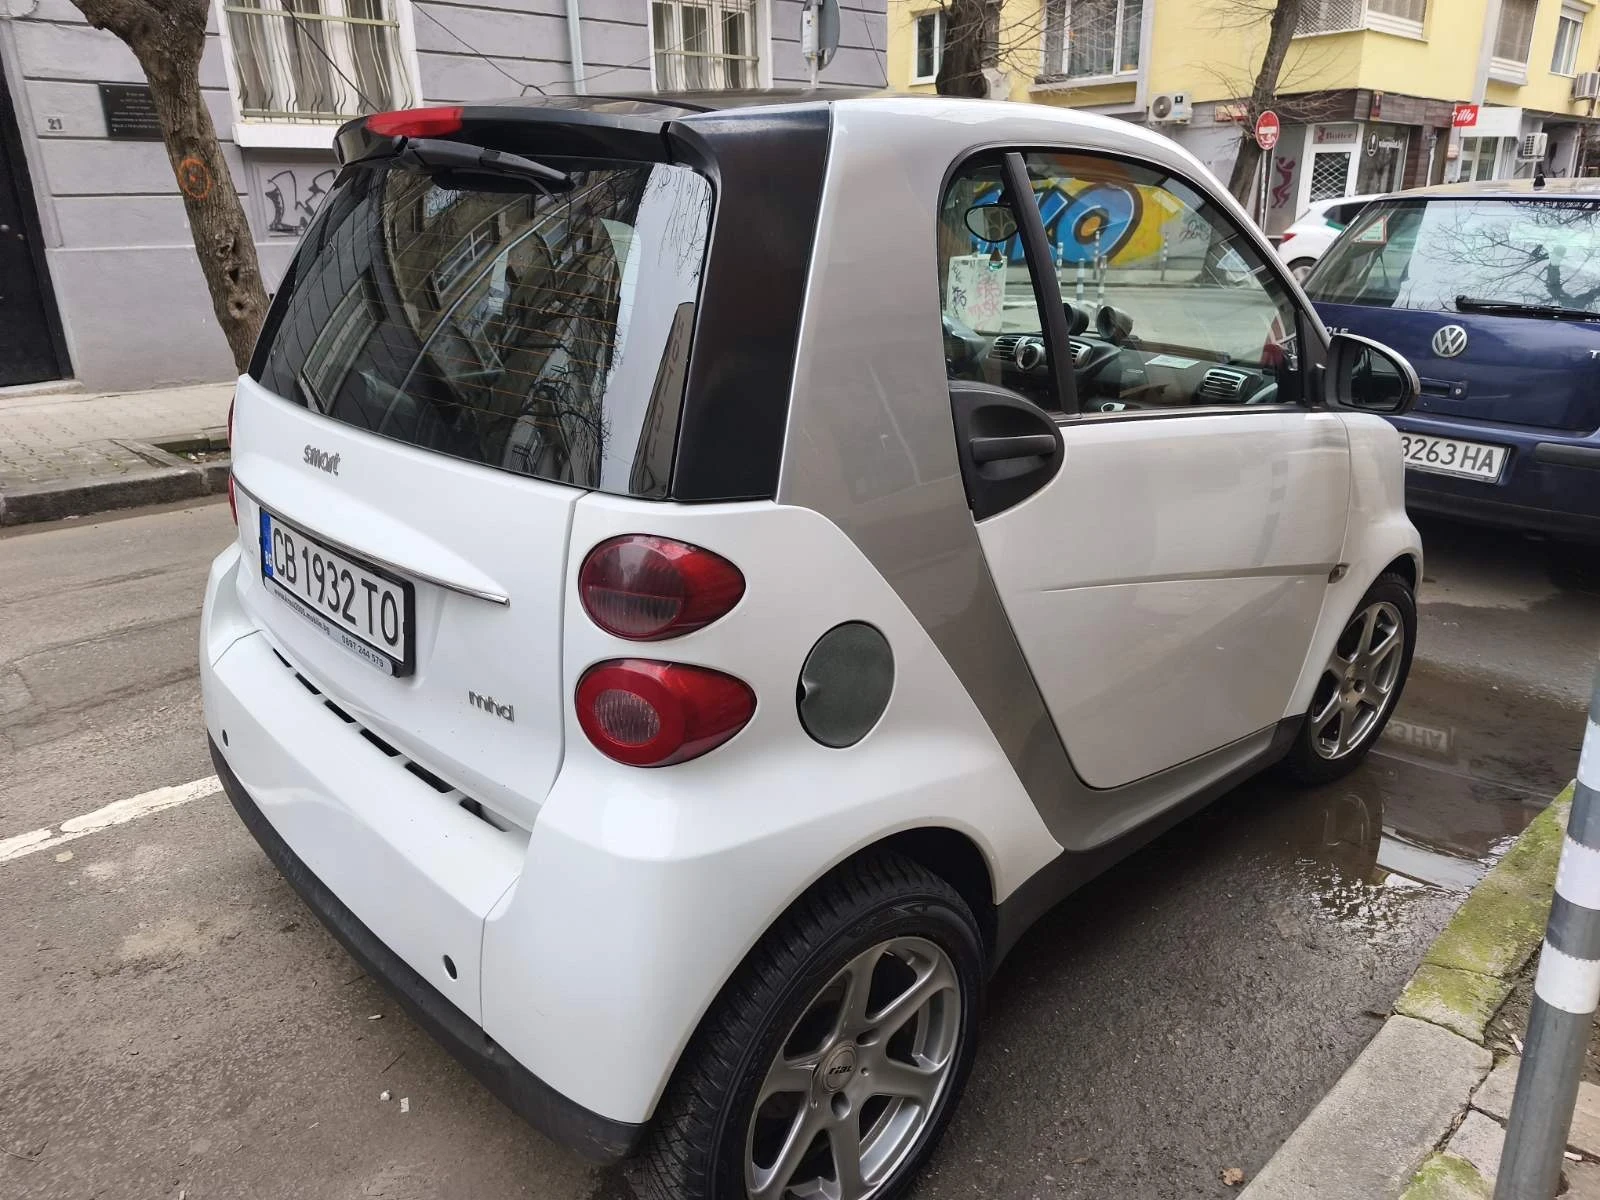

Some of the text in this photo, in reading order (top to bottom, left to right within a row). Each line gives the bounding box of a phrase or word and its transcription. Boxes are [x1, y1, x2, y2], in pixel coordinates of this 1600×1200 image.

[47, 118, 63, 130] 21
[1456, 108, 1475, 123] illy
[303, 444, 341, 477] smart
[1459, 445, 1494, 473] HA
[273, 527, 399, 647] CB 1932 TO
[469, 690, 515, 722] mhd
